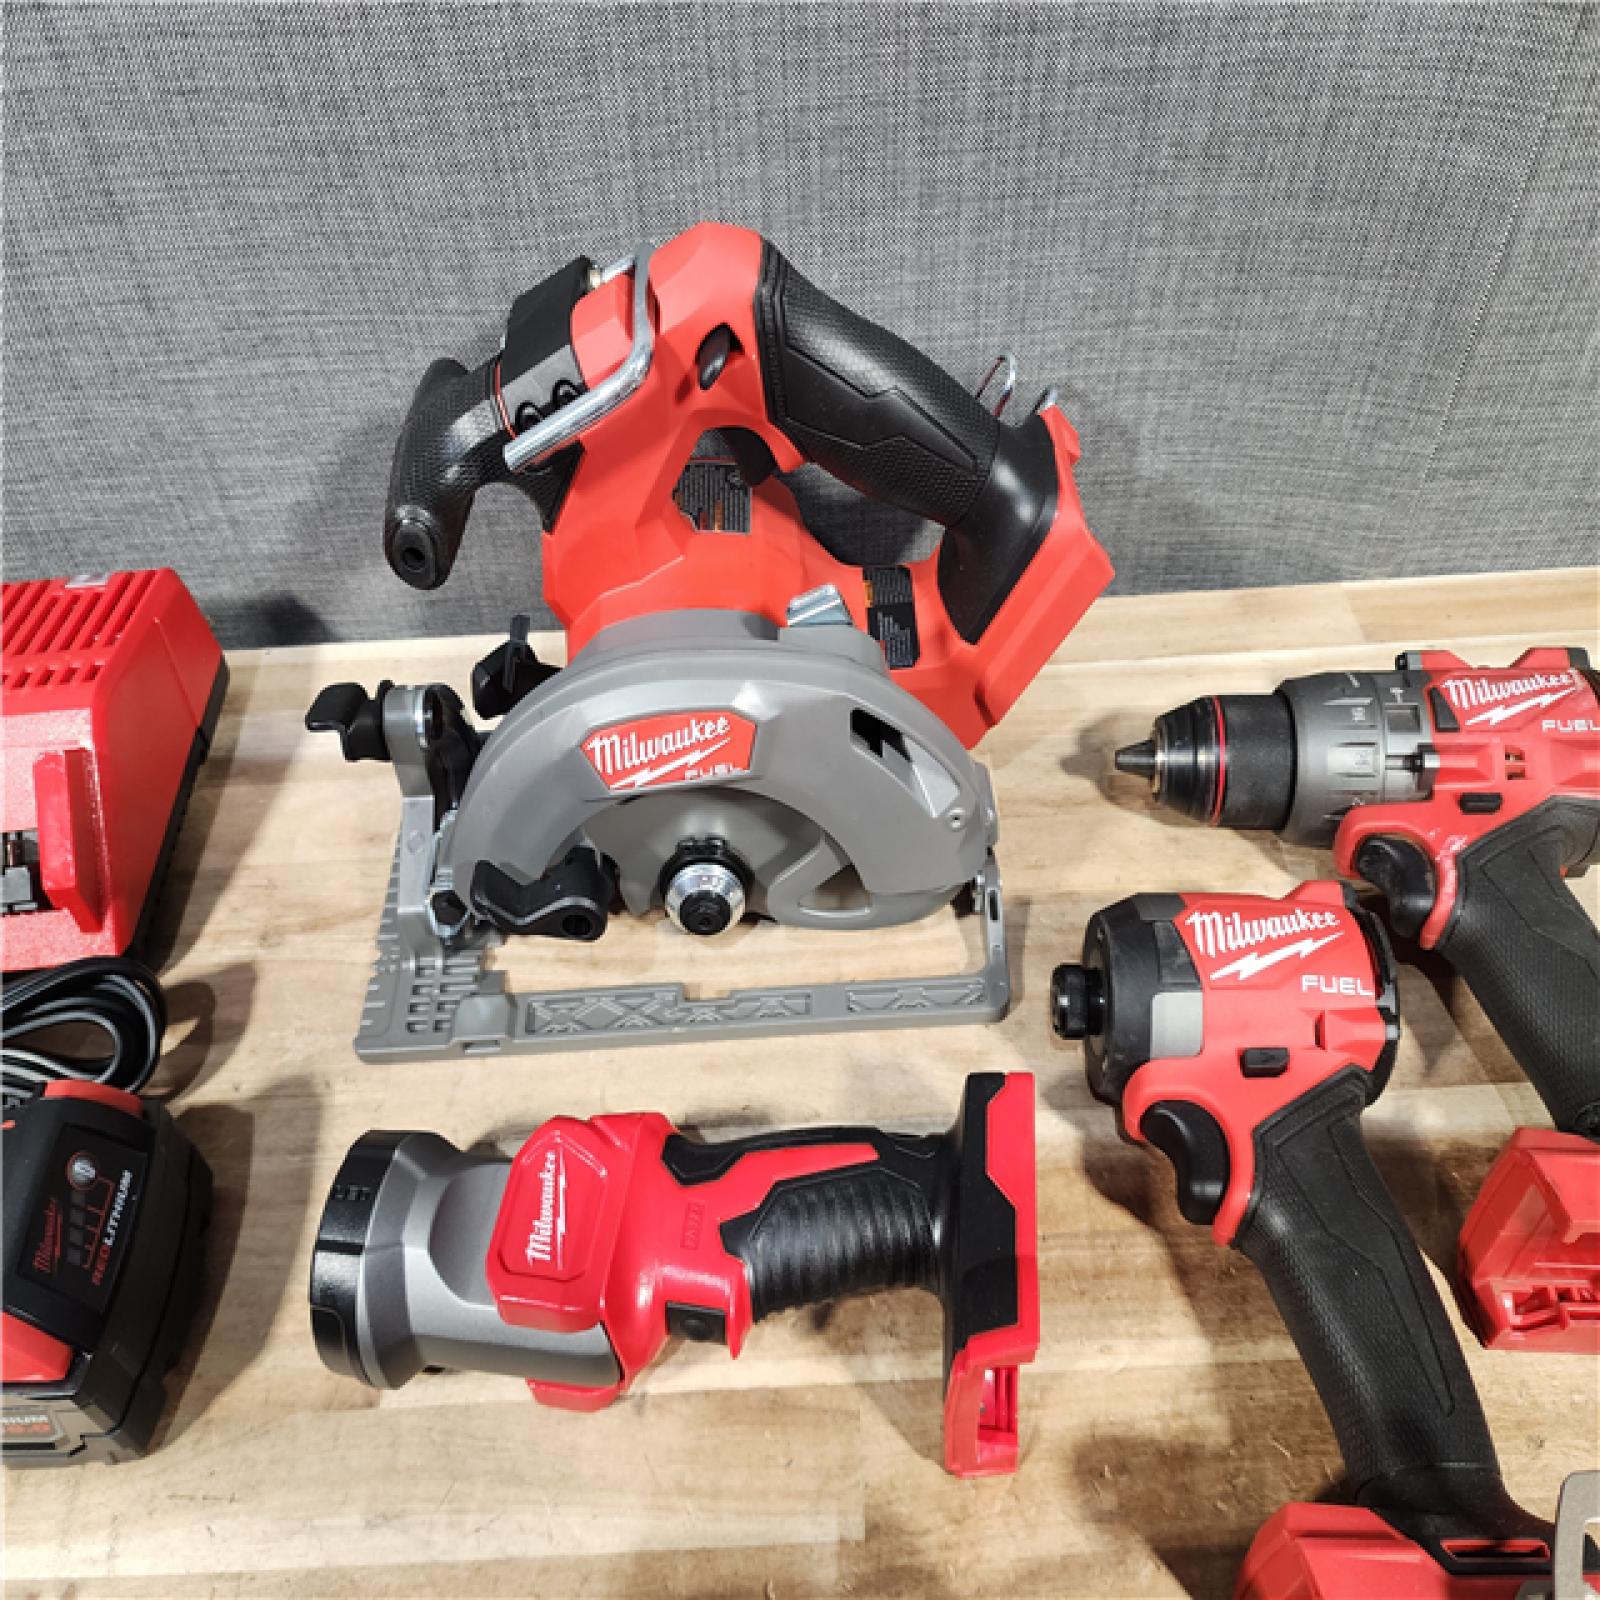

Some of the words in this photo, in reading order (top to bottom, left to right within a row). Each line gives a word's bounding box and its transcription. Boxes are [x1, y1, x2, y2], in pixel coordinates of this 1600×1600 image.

[1441, 673, 1572, 710] Milwaukee
[587, 716, 731, 775] Milwaukee
[1184, 907, 1341, 958] Milwaukee
[1301, 974, 1376, 996] FUEL
[525, 1149, 556, 1268] Milwaukee
